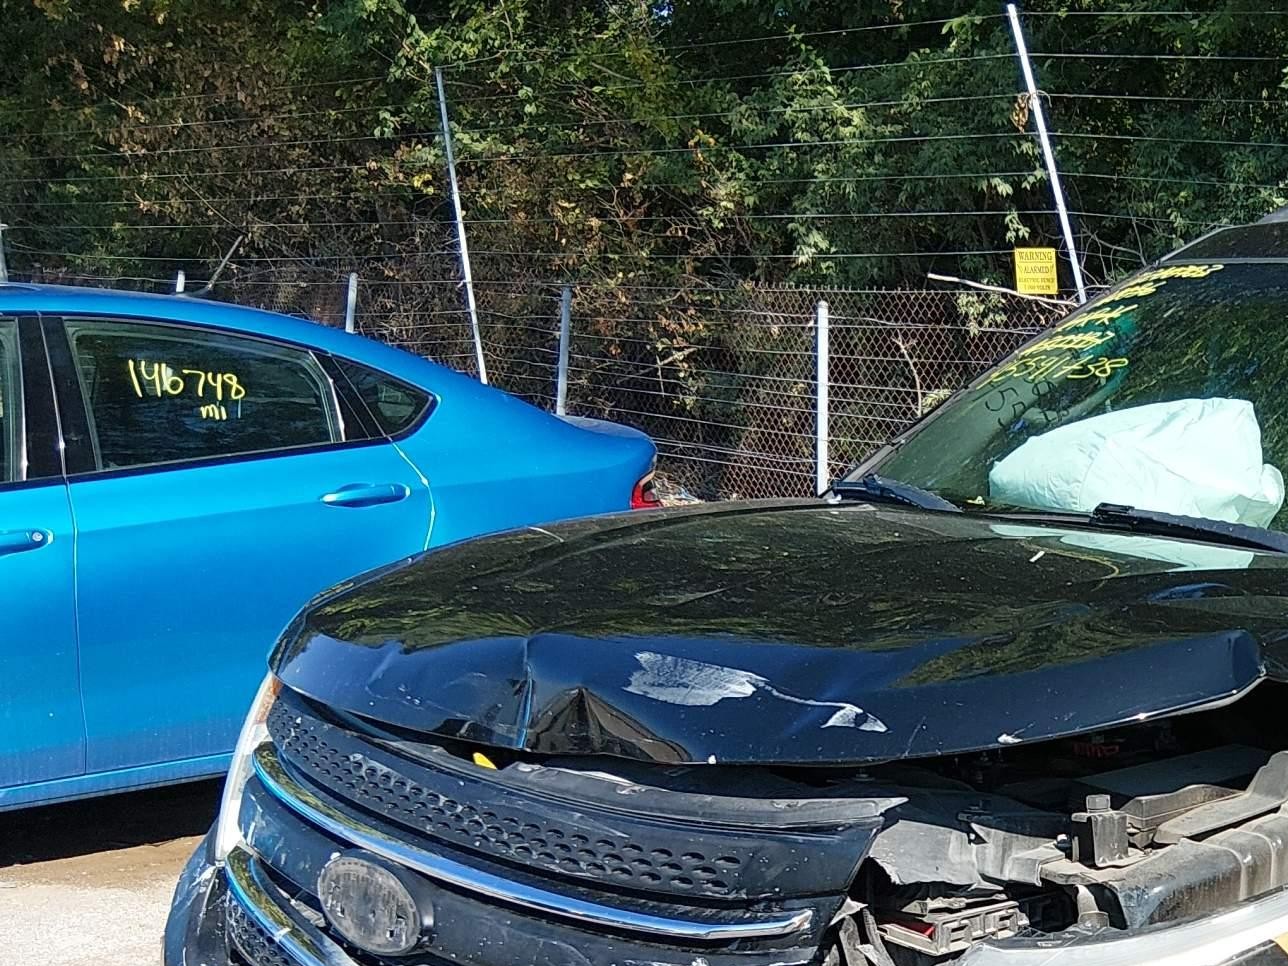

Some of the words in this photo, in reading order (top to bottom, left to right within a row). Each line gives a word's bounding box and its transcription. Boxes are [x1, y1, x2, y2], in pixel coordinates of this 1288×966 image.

[1018, 251, 1053, 261] WARNING
[128, 359, 246, 400] 146748
[200, 404, 227, 421] mi
